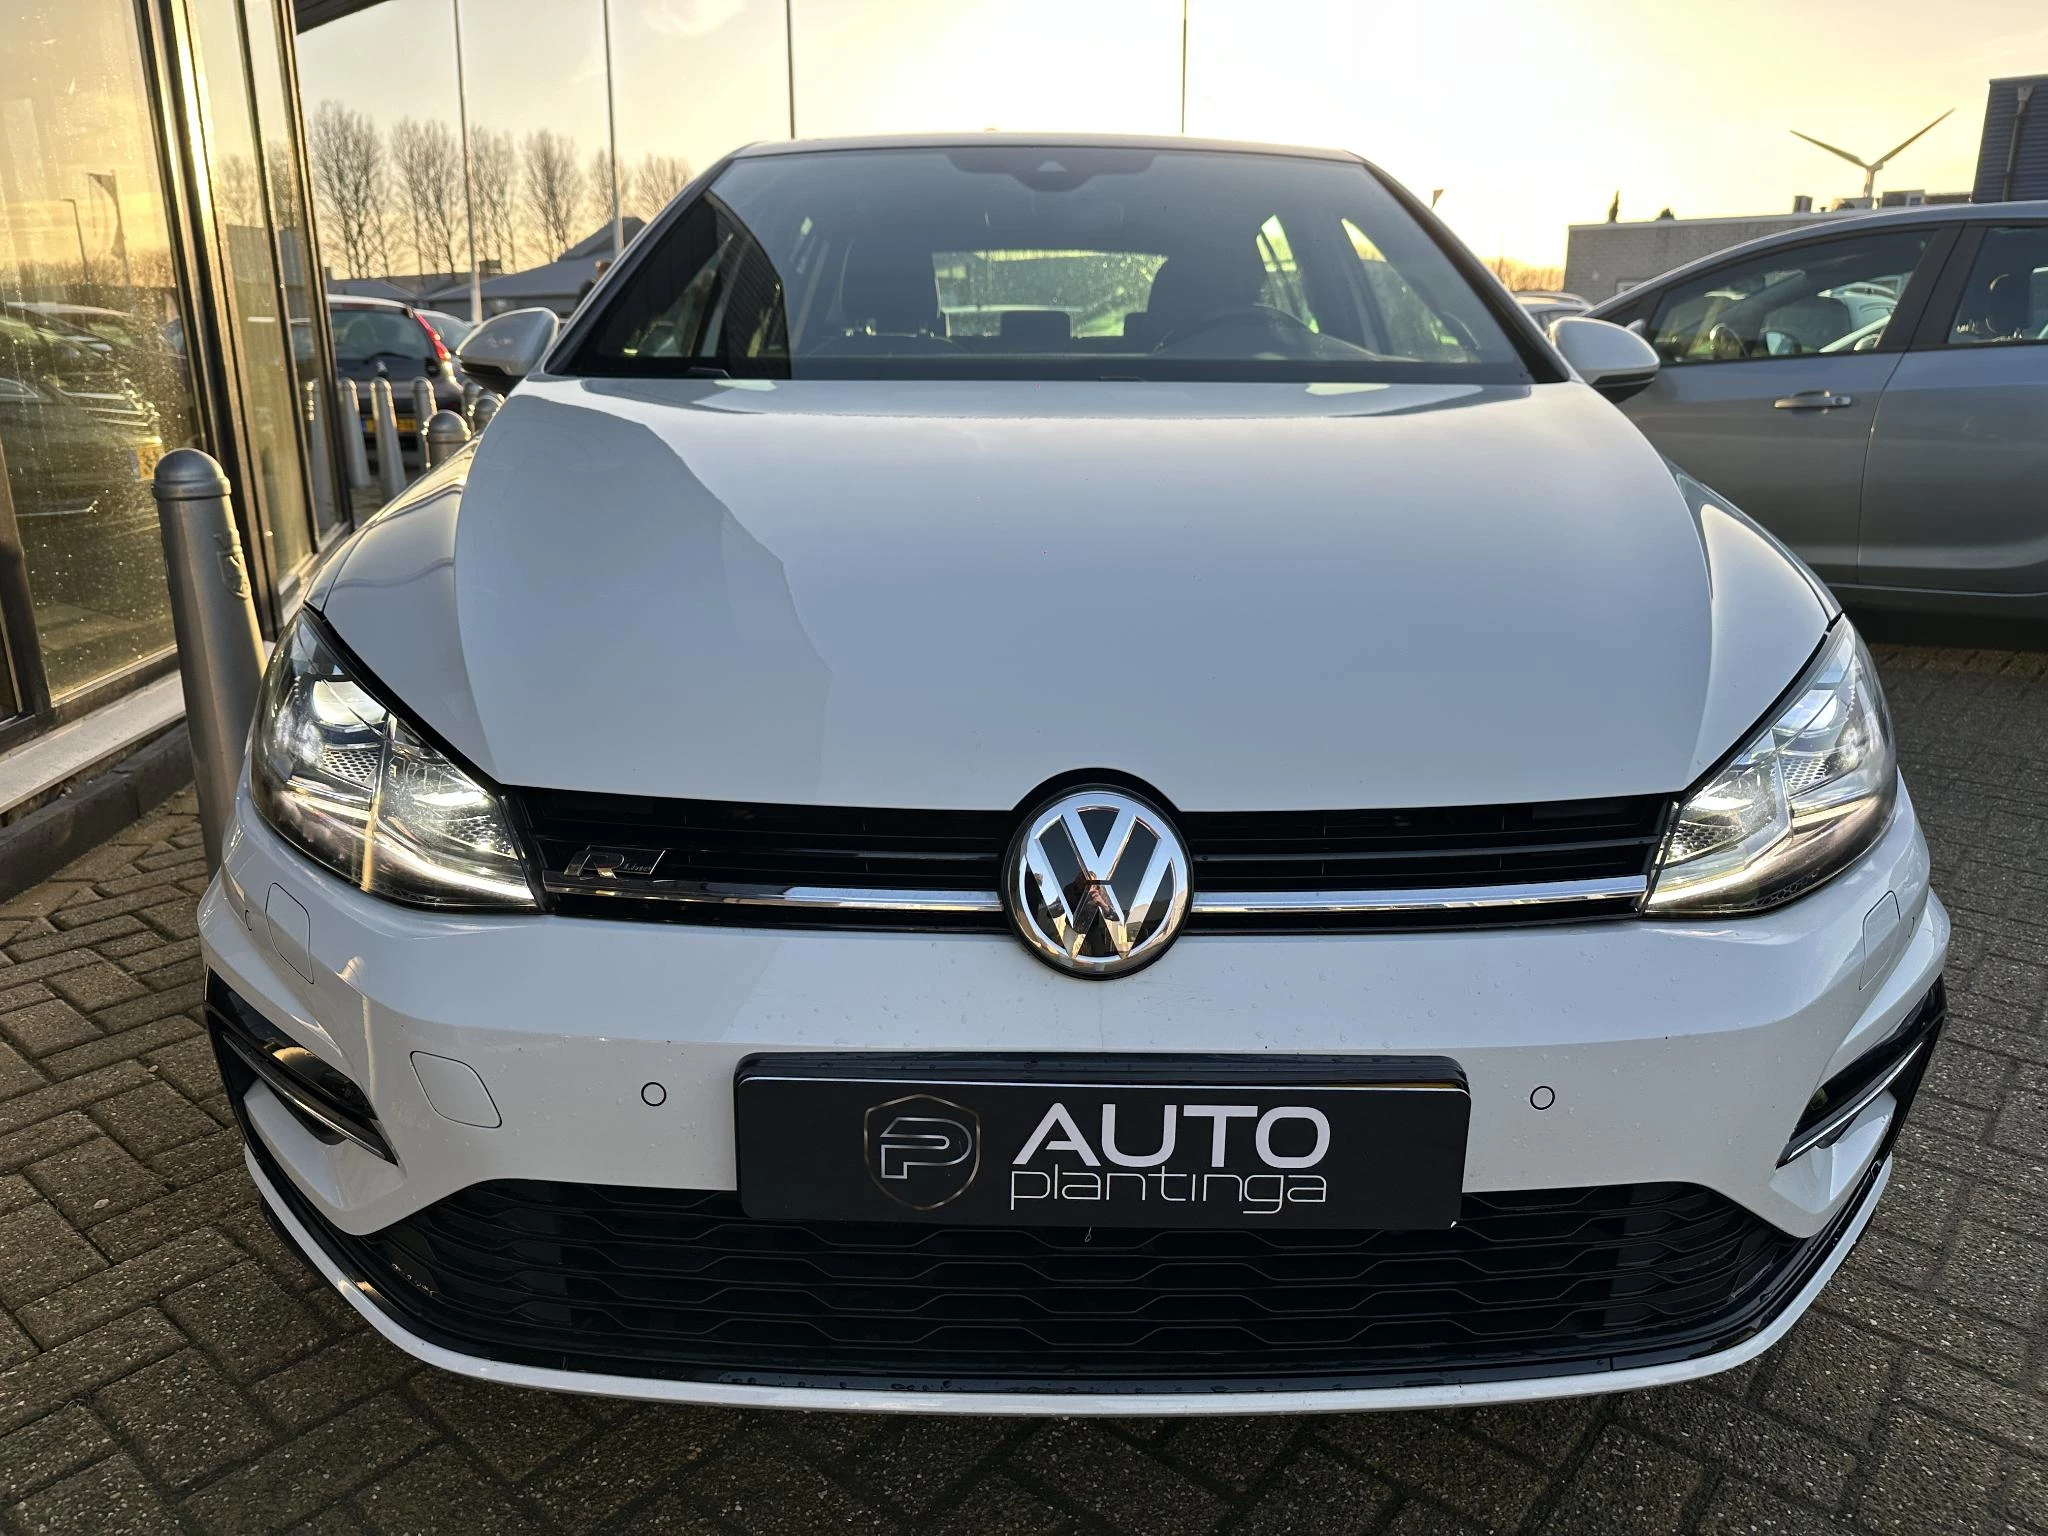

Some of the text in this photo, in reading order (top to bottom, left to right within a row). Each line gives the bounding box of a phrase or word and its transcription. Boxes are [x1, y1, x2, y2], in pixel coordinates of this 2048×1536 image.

[1021, 793, 1188, 966] VW
[1011, 1102, 1331, 1169] AUTO
[1010, 1163, 1328, 1215] plantinga
